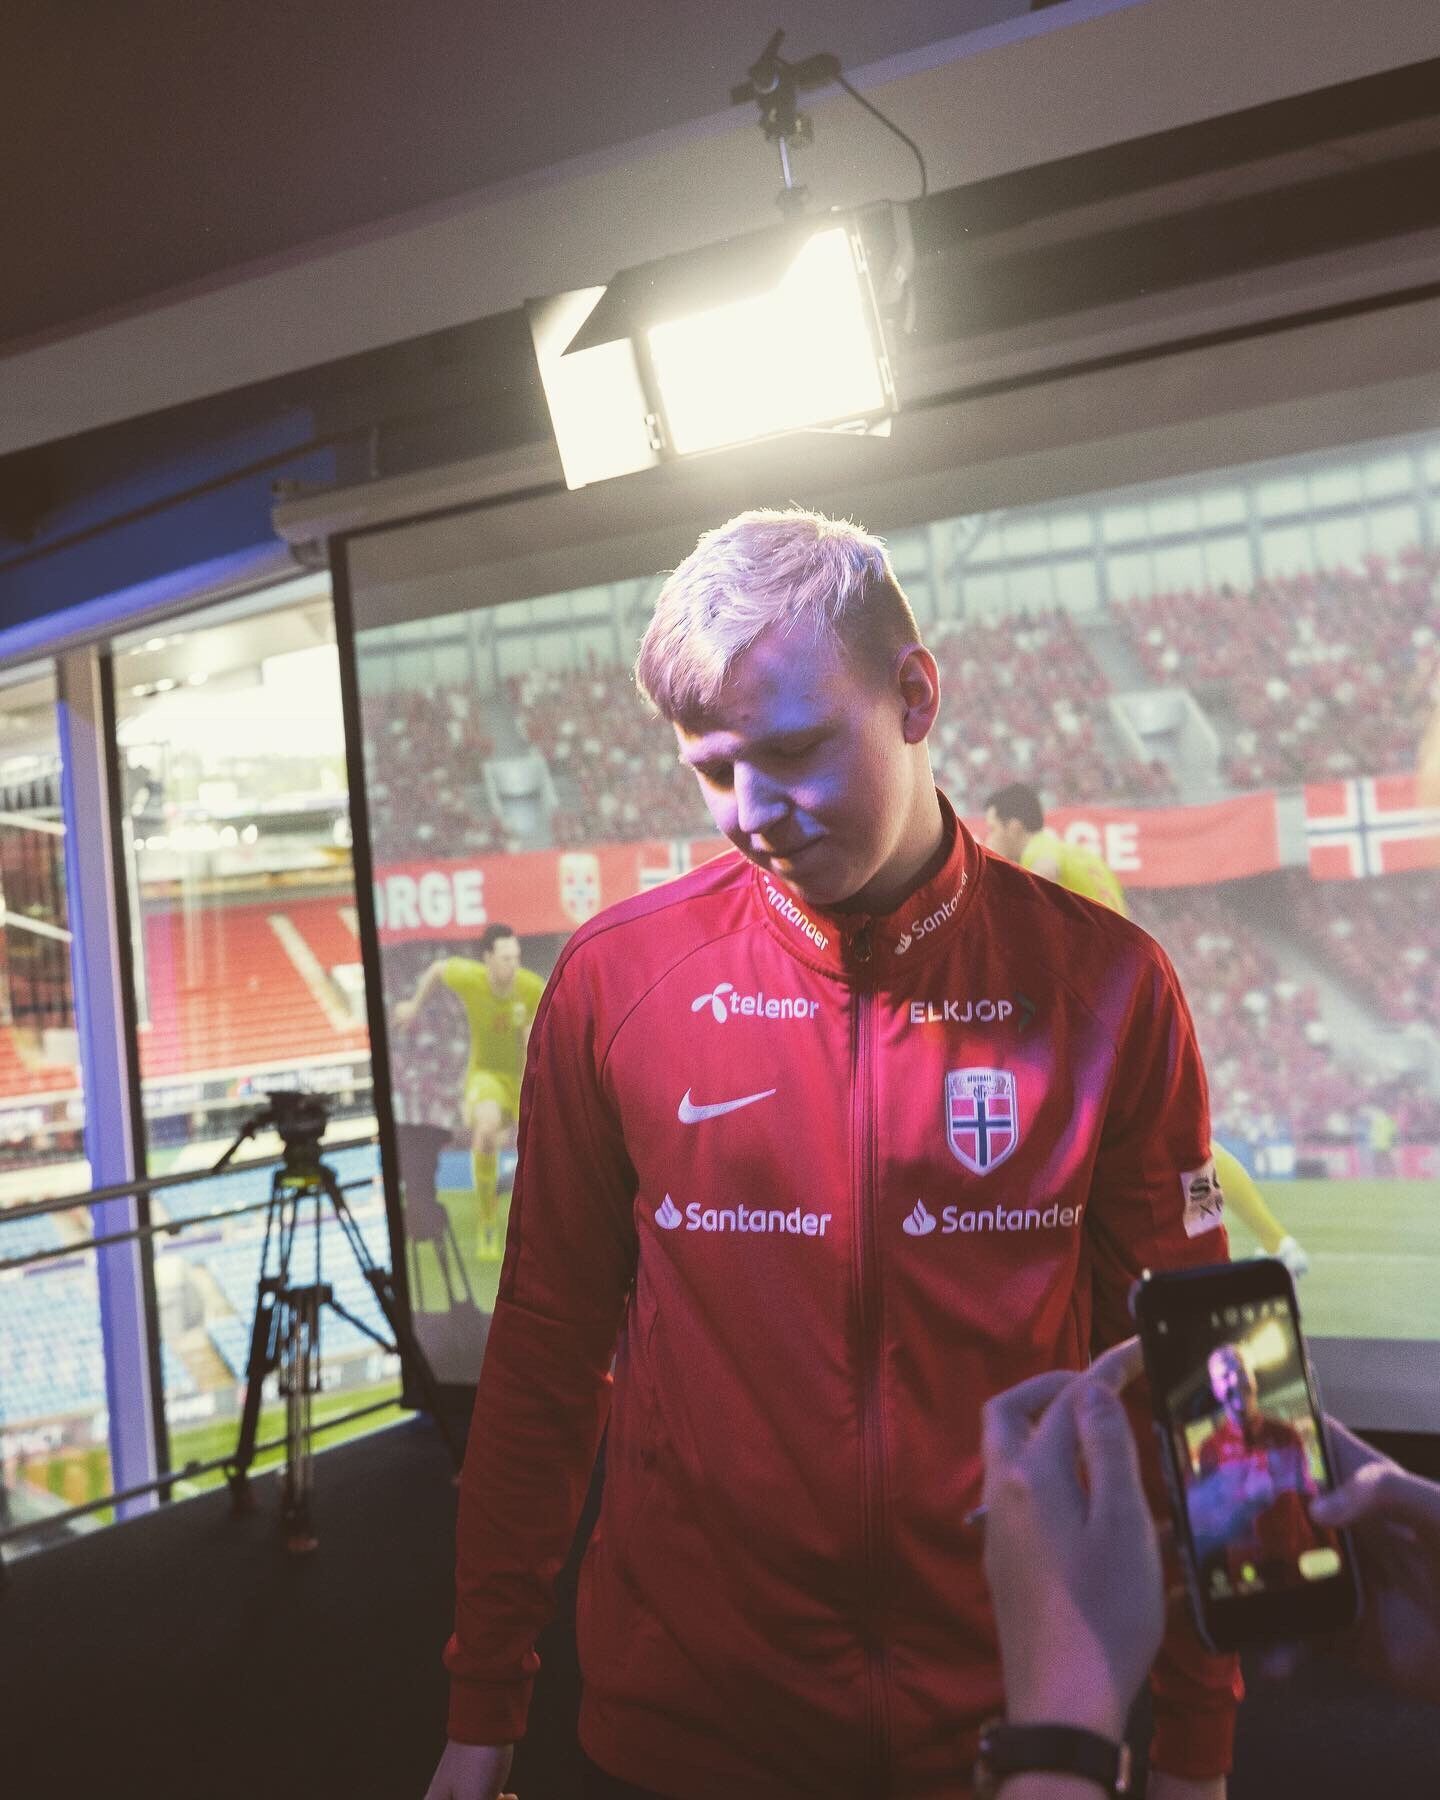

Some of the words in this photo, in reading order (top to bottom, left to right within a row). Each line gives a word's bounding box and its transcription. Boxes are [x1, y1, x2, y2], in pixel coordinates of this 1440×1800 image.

[763, 875, 829, 951] antander
[729, 991, 819, 1019] telenor
[685, 1202, 832, 1236] Santander
[942, 1202, 1082, 1234] Santander
